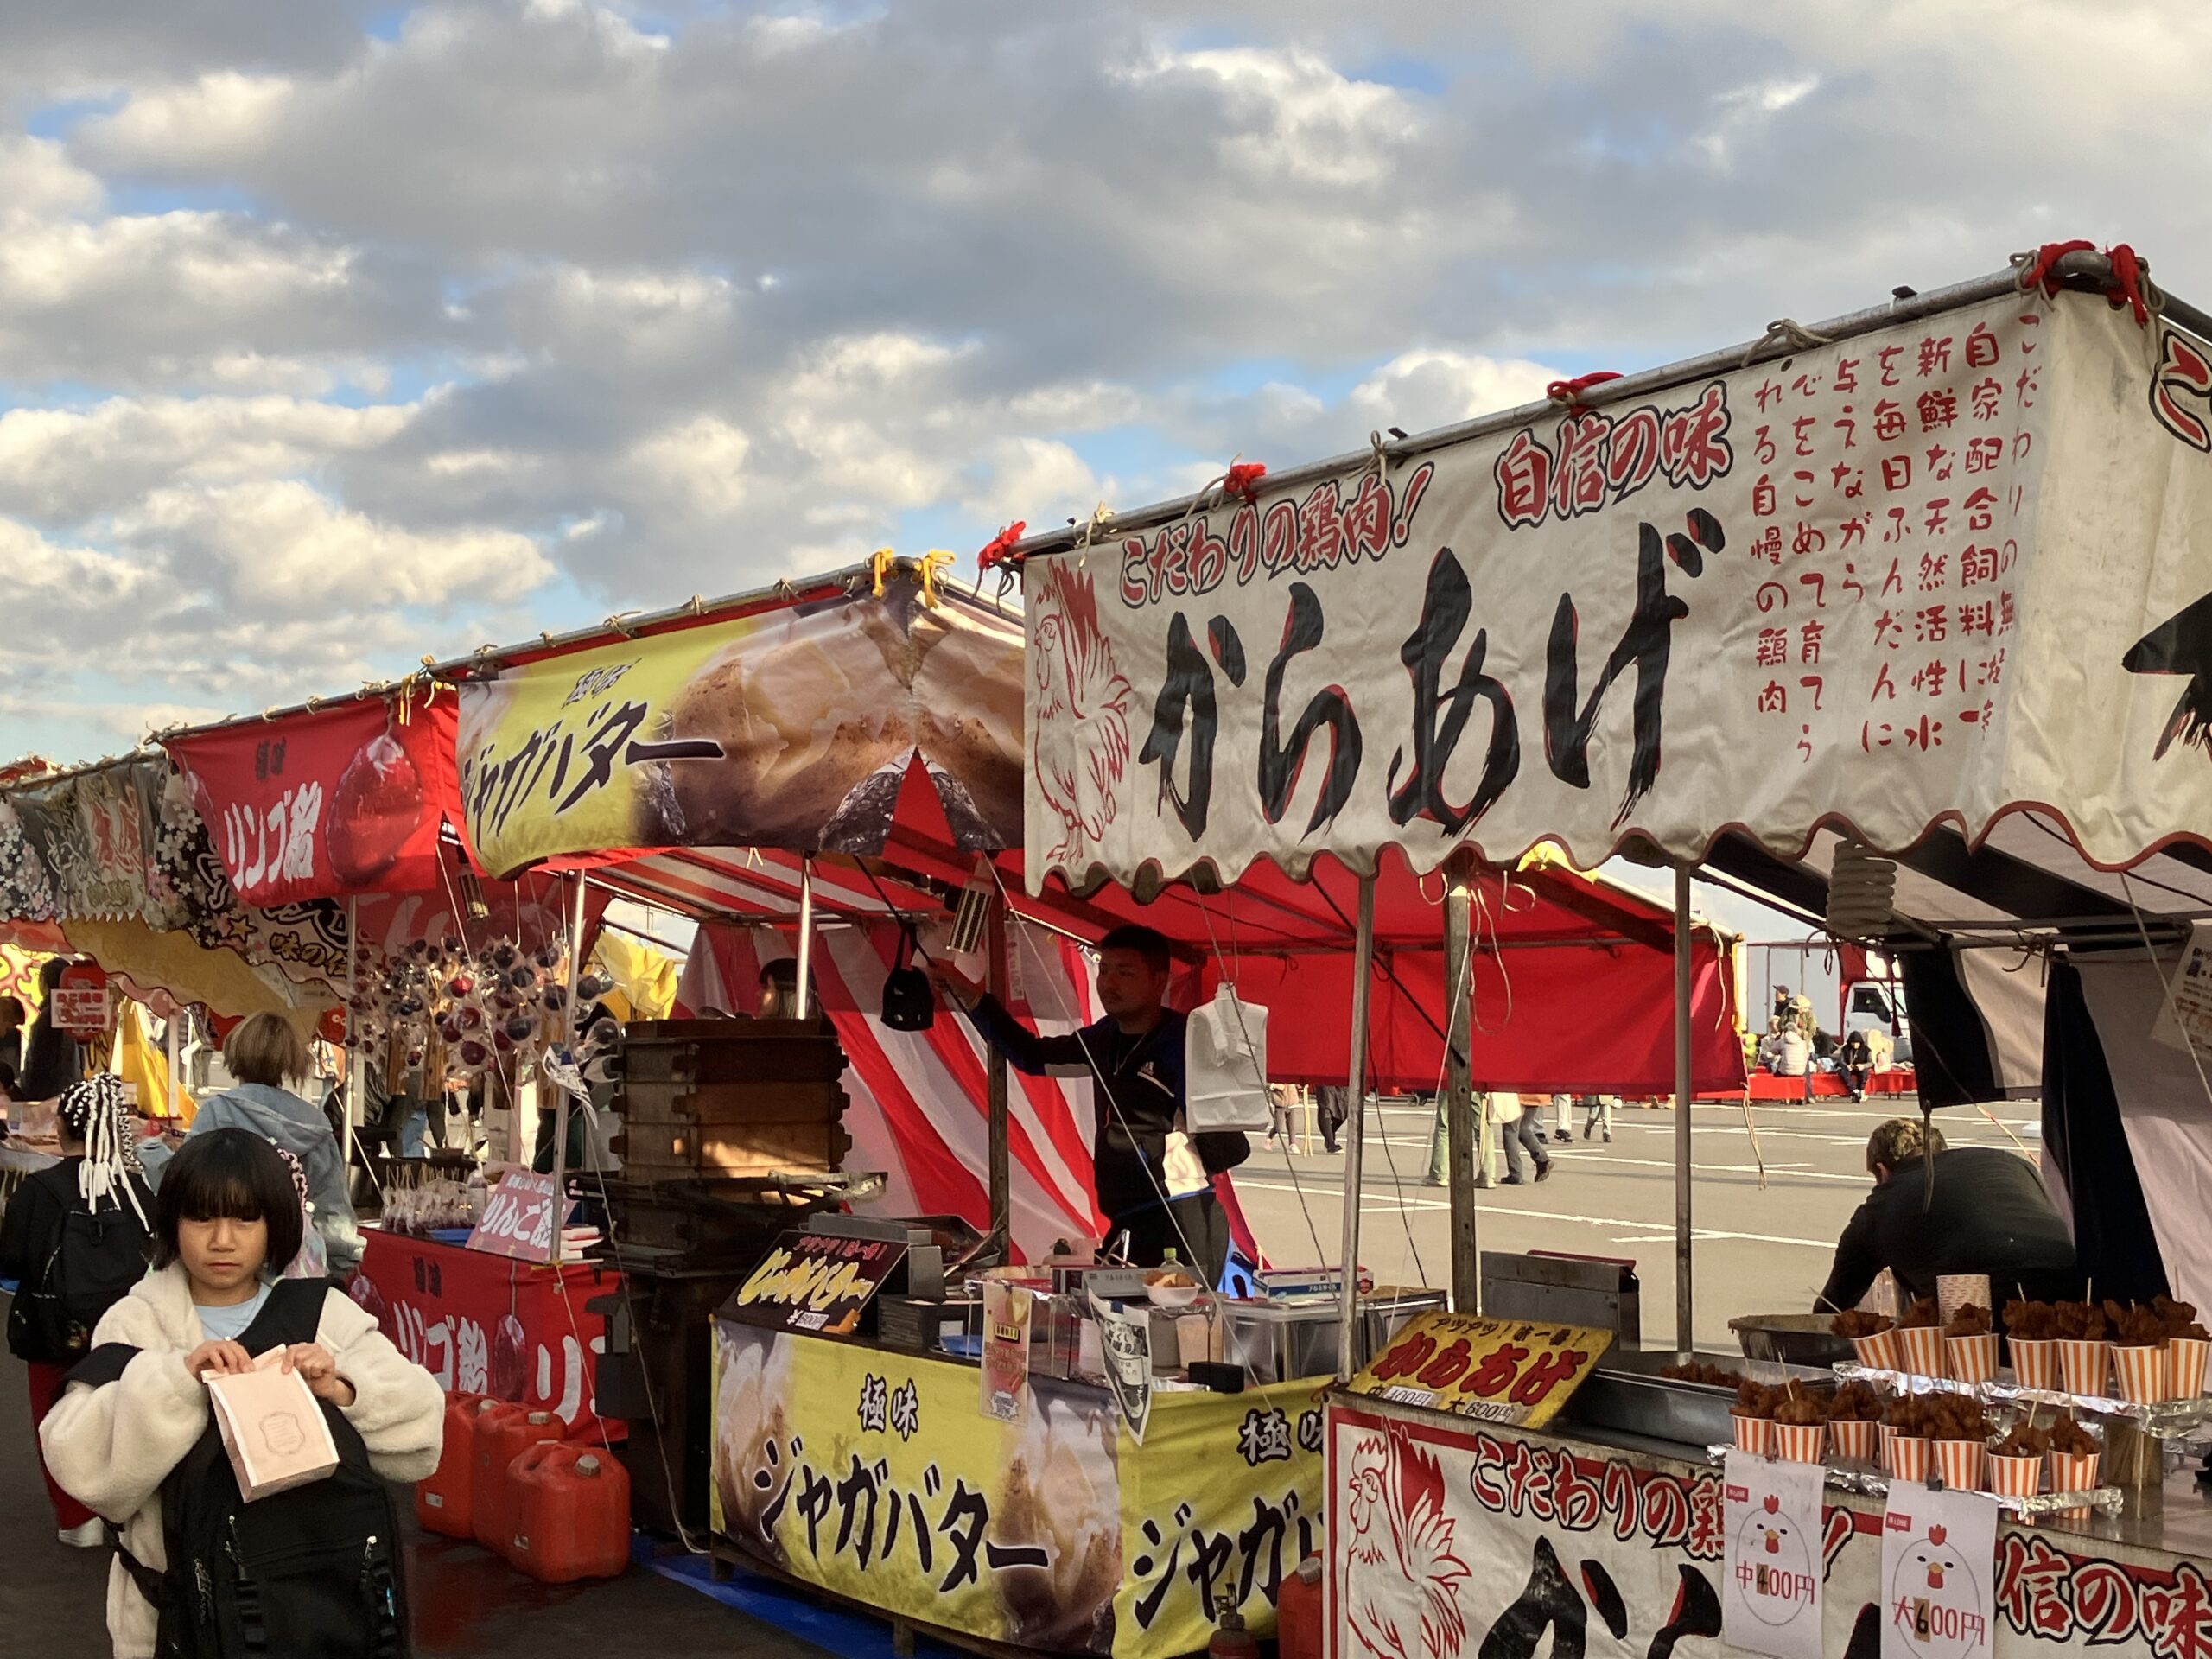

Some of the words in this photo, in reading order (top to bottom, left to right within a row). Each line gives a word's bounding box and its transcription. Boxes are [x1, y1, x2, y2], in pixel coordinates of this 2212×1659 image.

[1494, 380, 1734, 531] 自信の味
[1830, 359, 1873, 603] 与えながら
[1904, 337, 1959, 752] 新鮮な天然活性水
[1138, 508, 1726, 844] からあげ
[857, 1372, 919, 1442] 極味
[754, 1435, 1050, 1594] ジャガバター
